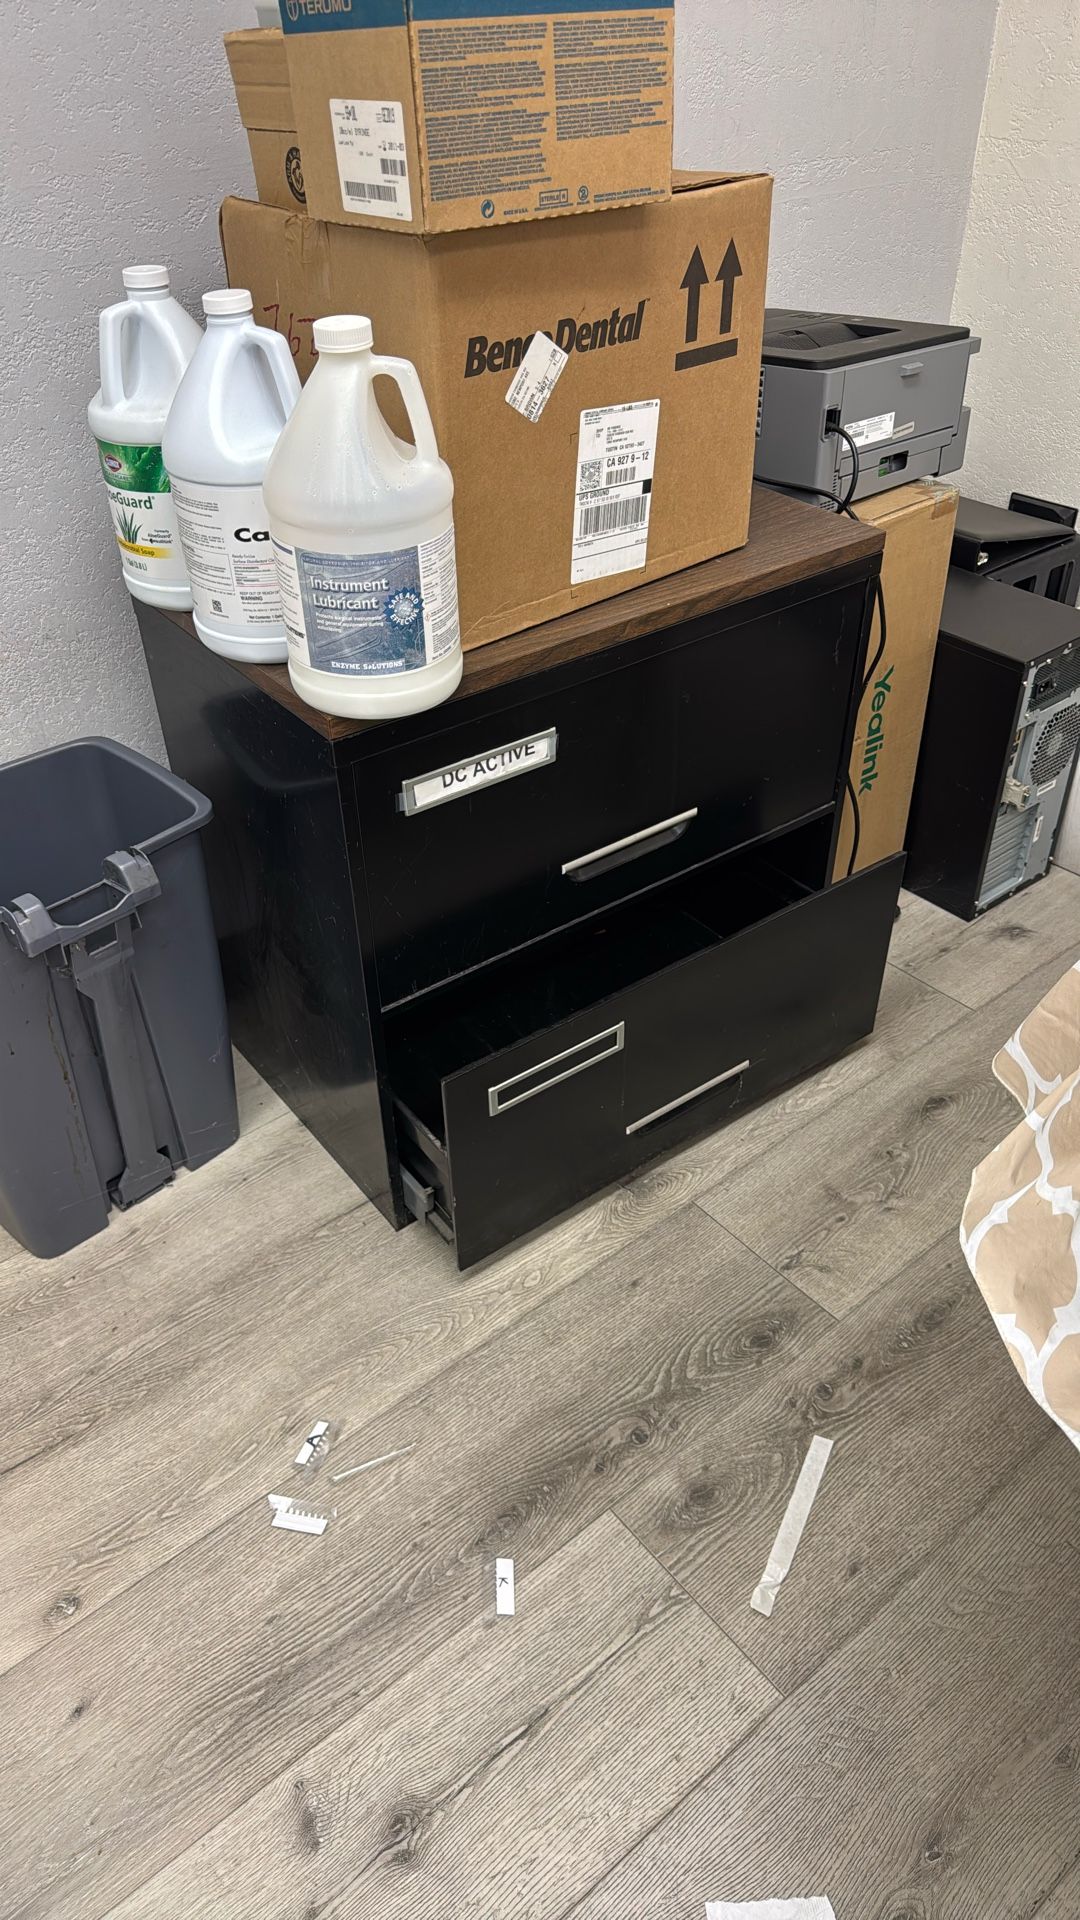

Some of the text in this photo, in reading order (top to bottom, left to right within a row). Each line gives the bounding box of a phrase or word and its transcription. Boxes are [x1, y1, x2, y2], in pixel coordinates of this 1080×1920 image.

[606, 457, 615, 467] CA
[617, 455, 629, 465] 927
[589, 489, 609, 498] GROUND
[234, 527, 270, 542] Ca
[310, 576, 389, 592] Instrument
[312, 594, 380, 610] Lubricant
[388, 592, 404, 609] SAFE
[405, 592, 418, 604] AND
[390, 608, 419, 625] EFFECTIVE
[331, 661, 360, 670] ENZYME
[858, 664, 894, 796] Yealink
[442, 744, 536, 788] DC ACTIVE
[498, 1577, 508, 1588] K
